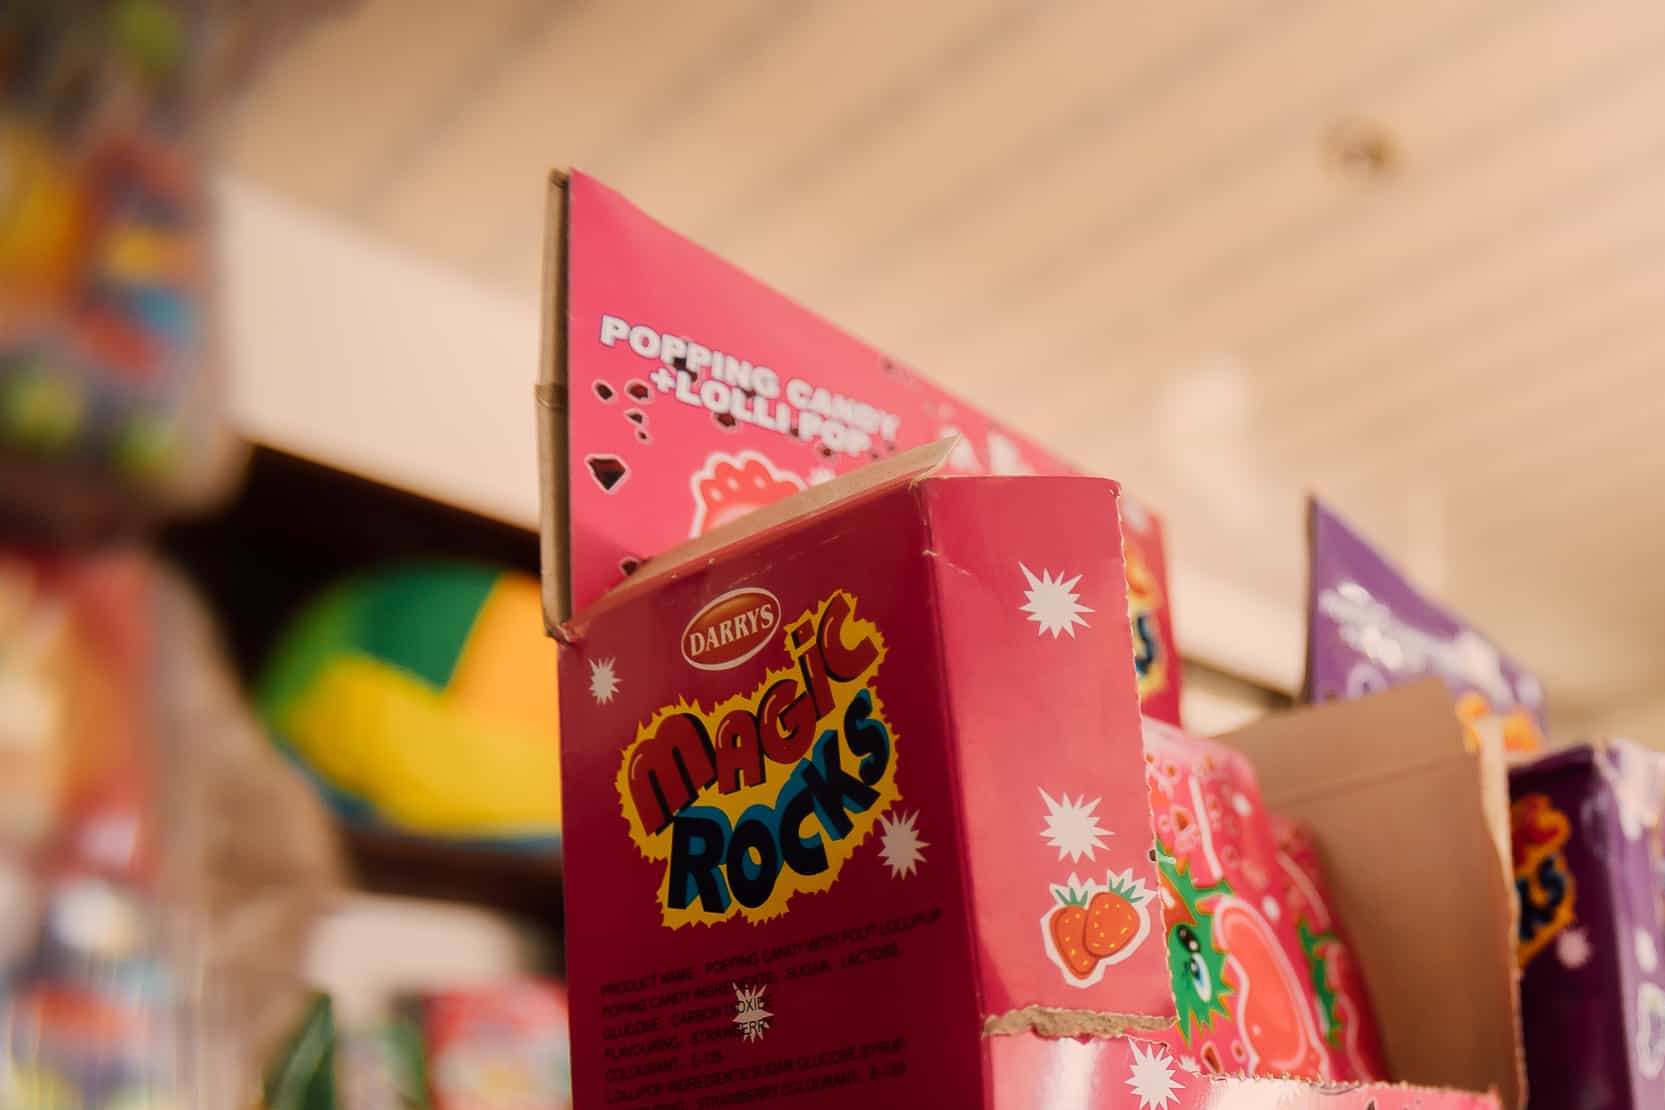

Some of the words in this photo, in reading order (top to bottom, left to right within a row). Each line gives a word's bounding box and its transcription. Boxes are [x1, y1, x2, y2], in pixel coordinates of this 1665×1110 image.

[601, 315, 780, 398] POPPING
[786, 378, 900, 440] CANDY
[797, 411, 874, 456] POP
[689, 604, 775, 657] DARRYS
[667, 688, 892, 914] ROCKS
